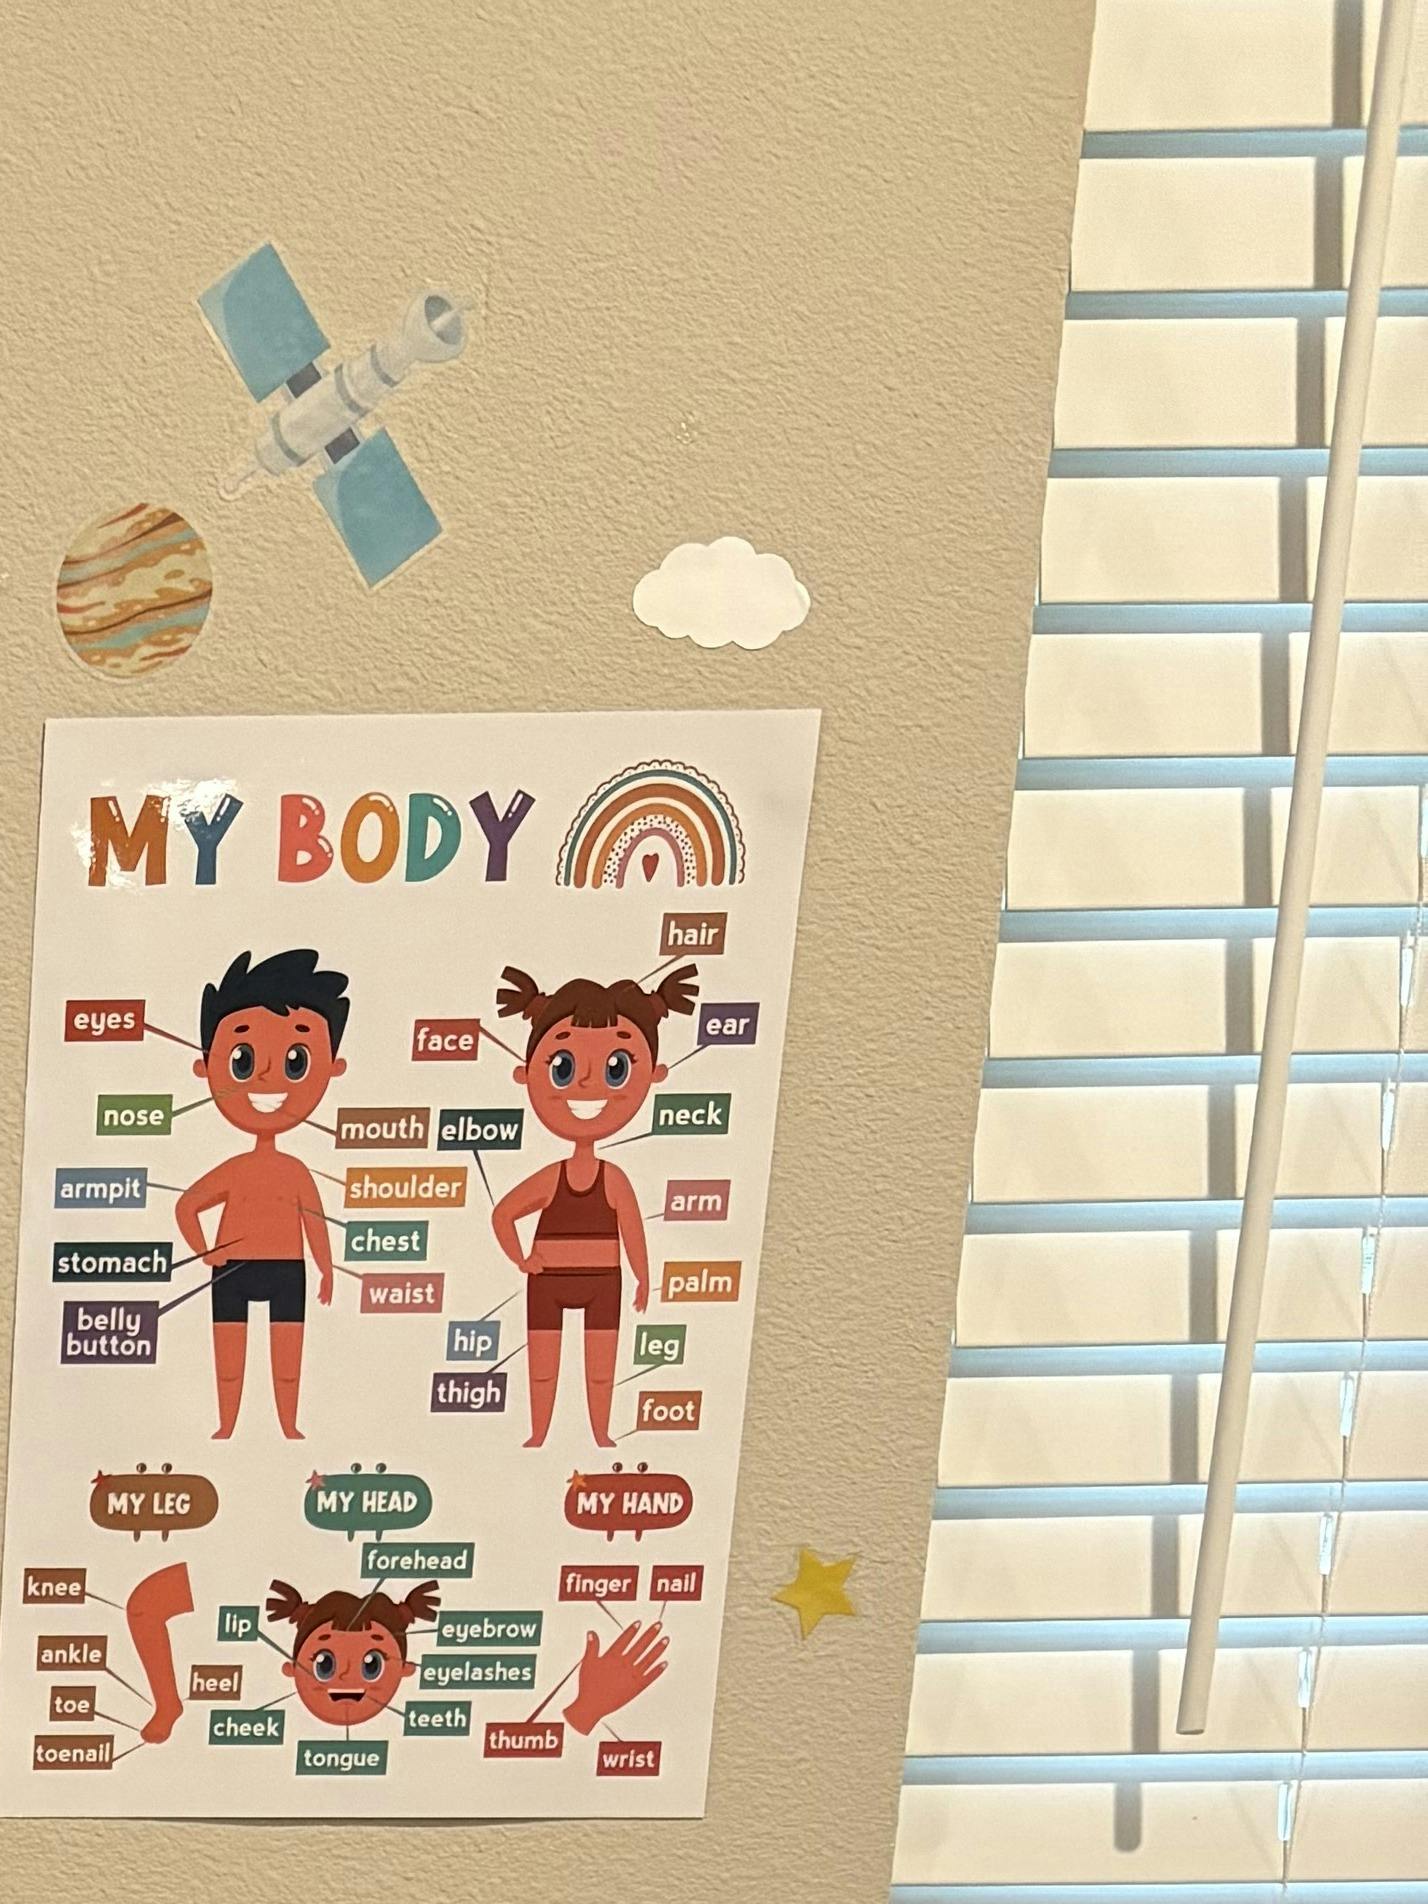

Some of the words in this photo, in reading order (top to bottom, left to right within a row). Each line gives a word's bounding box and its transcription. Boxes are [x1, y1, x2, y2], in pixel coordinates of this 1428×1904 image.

[87, 792, 244, 887] MY
[278, 789, 536, 885] BODY
[667, 922, 718, 947] hair
[72, 1008, 136, 1034] eyes
[705, 1013, 750, 1036] ear
[417, 1026, 475, 1054] face
[103, 1106, 165, 1126] nose
[659, 1103, 722, 1127] neck
[340, 1116, 425, 1141] mouth
[442, 1117, 519, 1142] elbow
[60, 1176, 141, 1203] armpit
[350, 1175, 462, 1200] shoulder
[670, 1190, 723, 1212] arm
[351, 1229, 421, 1253] chest
[58, 1251, 168, 1274] stomach
[369, 1282, 436, 1304] waist
[668, 1269, 733, 1298] palm
[77, 1308, 141, 1336] belly
[66, 1332, 152, 1356] button
[455, 1330, 493, 1356] hip
[640, 1333, 681, 1361] leg
[438, 1381, 502, 1408] thigh
[642, 1398, 696, 1422] foot
[107, 1492, 146, 1516] MY
[153, 1492, 191, 1515] LEG
[316, 1491, 355, 1514] MY
[362, 1491, 418, 1514] HEAD
[576, 1492, 616, 1516] MY
[622, 1492, 683, 1516] HAND
[367, 1549, 468, 1572] forehead
[27, 1578, 82, 1596] knee
[565, 1574, 632, 1596] finger
[657, 1573, 696, 1592] nail
[225, 1612, 252, 1638] lip
[442, 1619, 537, 1641] eyebrow
[41, 1644, 102, 1664] ankle
[192, 1671, 239, 1691] heel
[423, 1662, 532, 1685] eyelashes
[54, 1696, 90, 1715] toe
[213, 1718, 280, 1738] cheek
[408, 1709, 467, 1729] teeth
[488, 1730, 558, 1750] thumb
[36, 1743, 111, 1764] toenail
[303, 1748, 380, 1771] tongue
[602, 1749, 655, 1769] wrist
